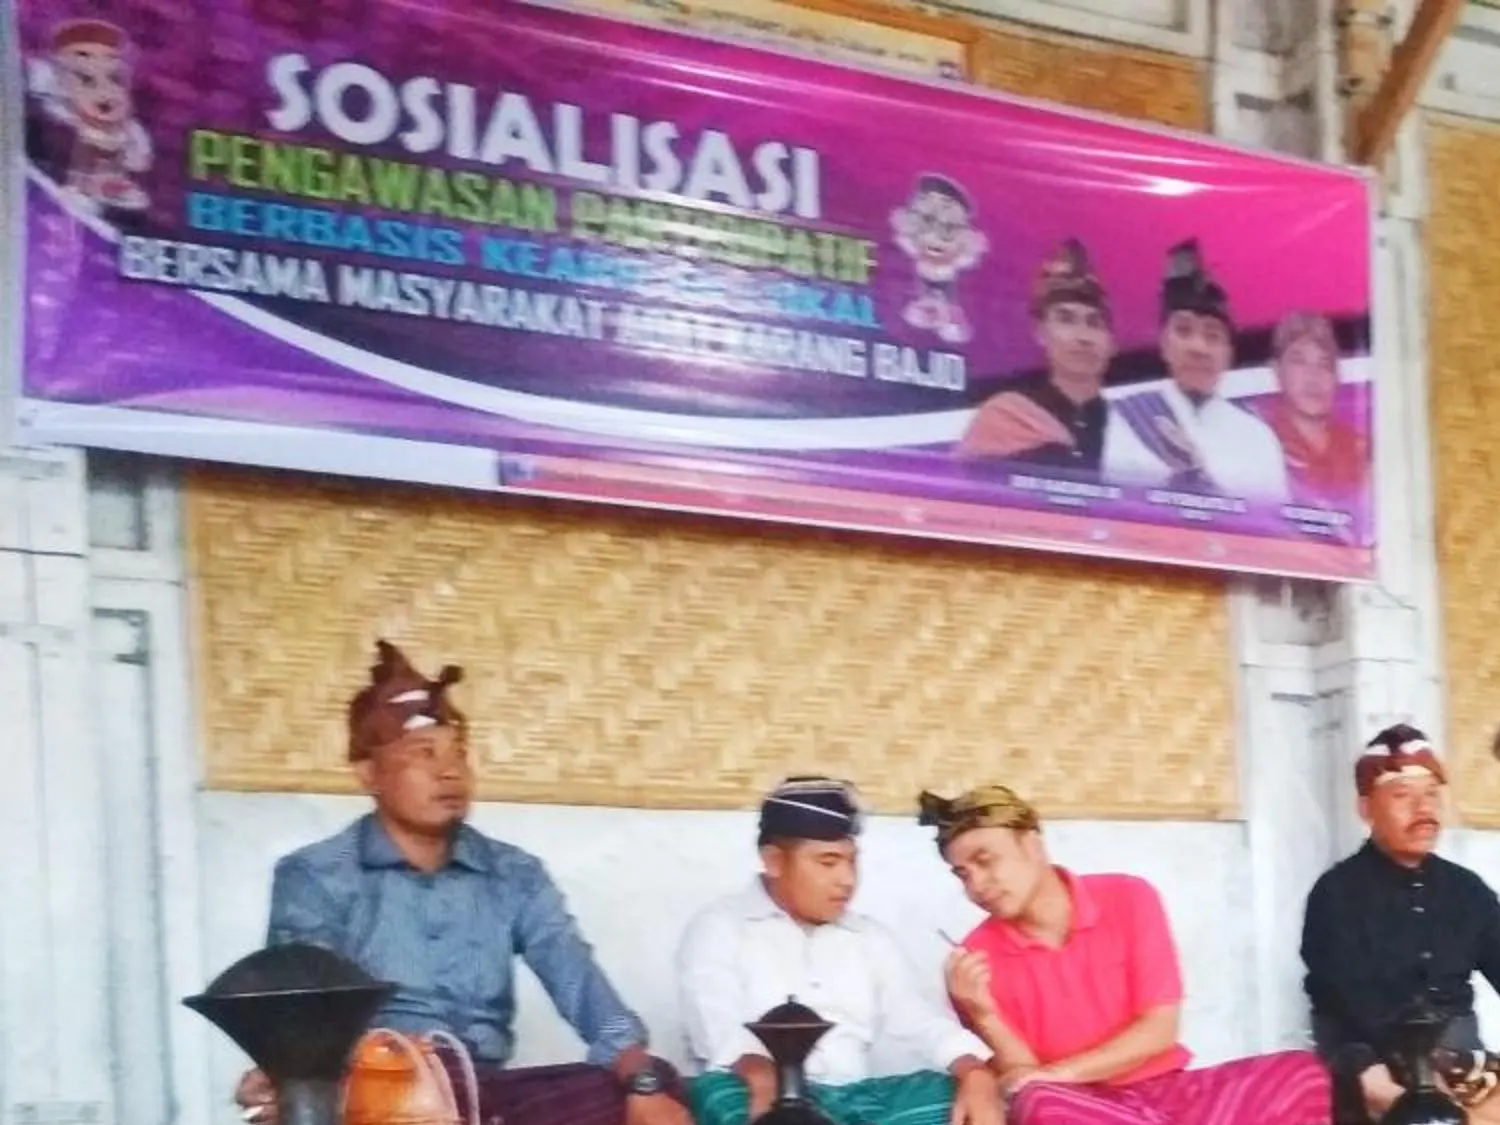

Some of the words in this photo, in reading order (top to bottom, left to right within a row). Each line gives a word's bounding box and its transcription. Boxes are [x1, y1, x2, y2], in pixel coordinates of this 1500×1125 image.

[189, 128, 558, 232] PENGAWASAN
[266, 52, 821, 219] SOSIALISASI
[119, 235, 329, 302] BERSAMA
[337, 263, 605, 339] MASYARAKAT
[873, 341, 966, 392] BAJO
[187, 191, 466, 265] BERBASIS
[736, 276, 880, 329] KAL
